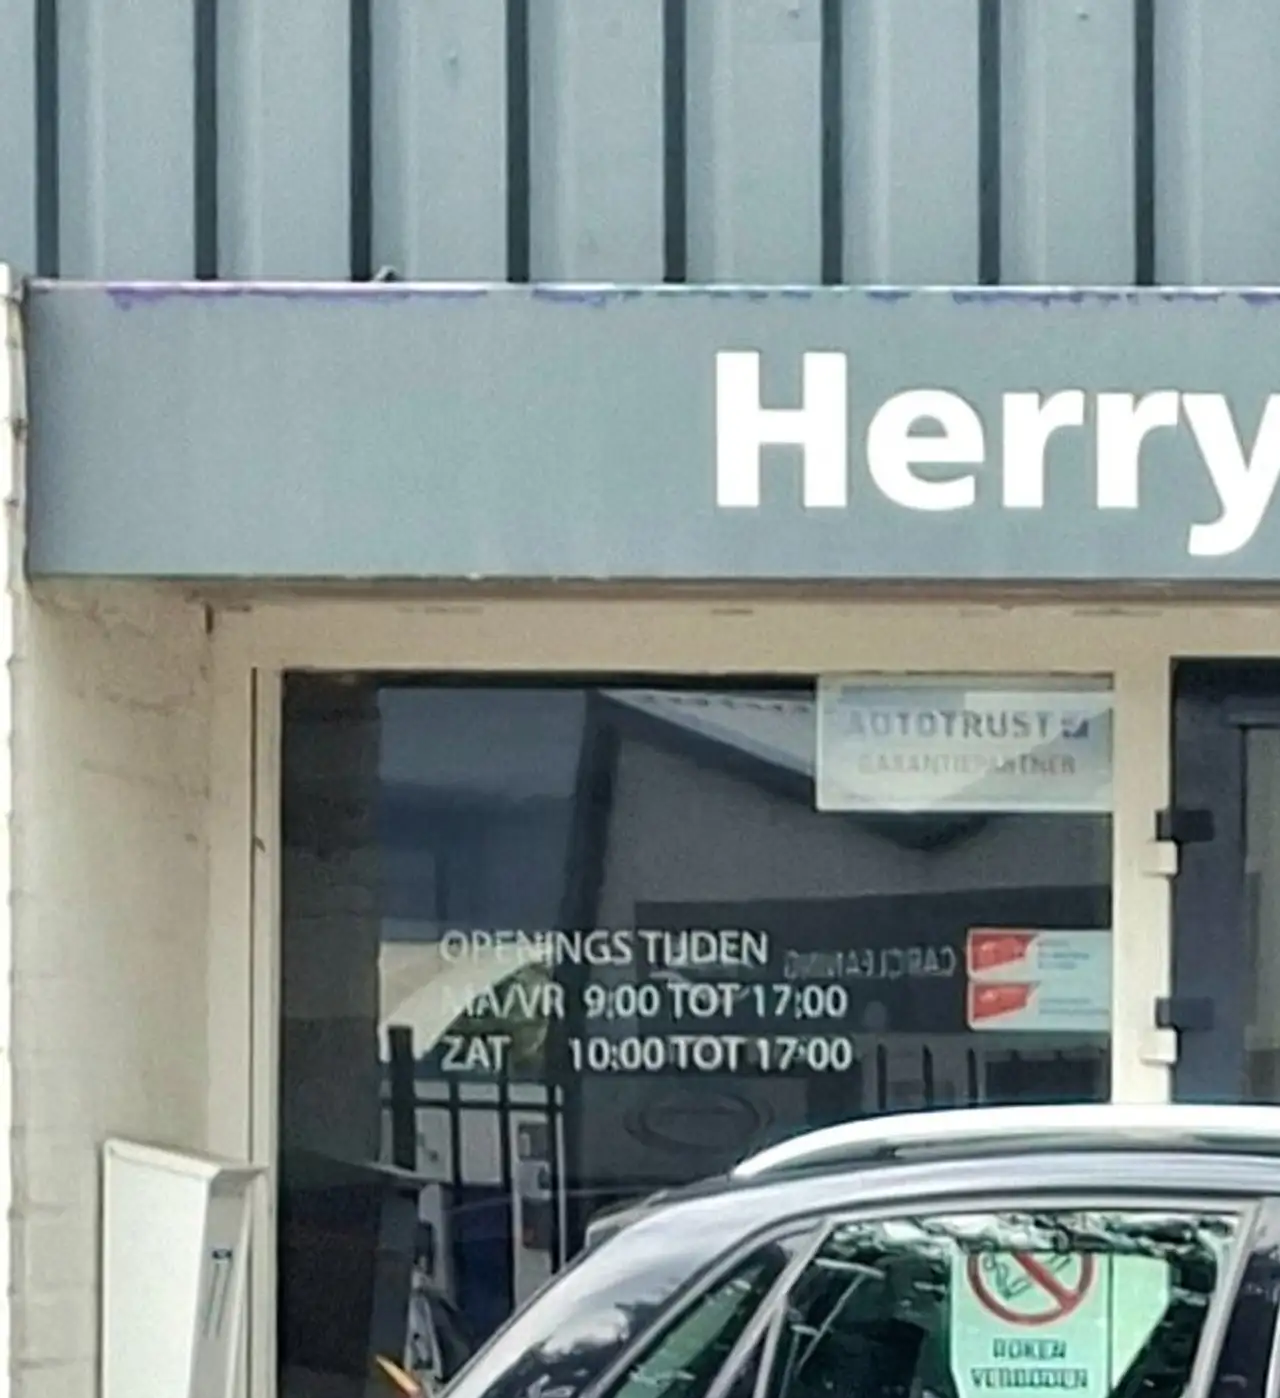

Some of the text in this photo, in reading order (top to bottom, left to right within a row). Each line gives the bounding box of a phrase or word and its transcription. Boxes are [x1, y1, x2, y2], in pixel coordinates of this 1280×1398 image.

[847, 710, 1054, 739] AUTOTRUST
[439, 929, 631, 966] OPENINGS
[584, 984, 661, 1019] 9:00
[669, 984, 738, 1018] TOT
[752, 983, 848, 1019] 17:00
[441, 1035, 853, 1072] ZAT 10:00 TOT 17:00
